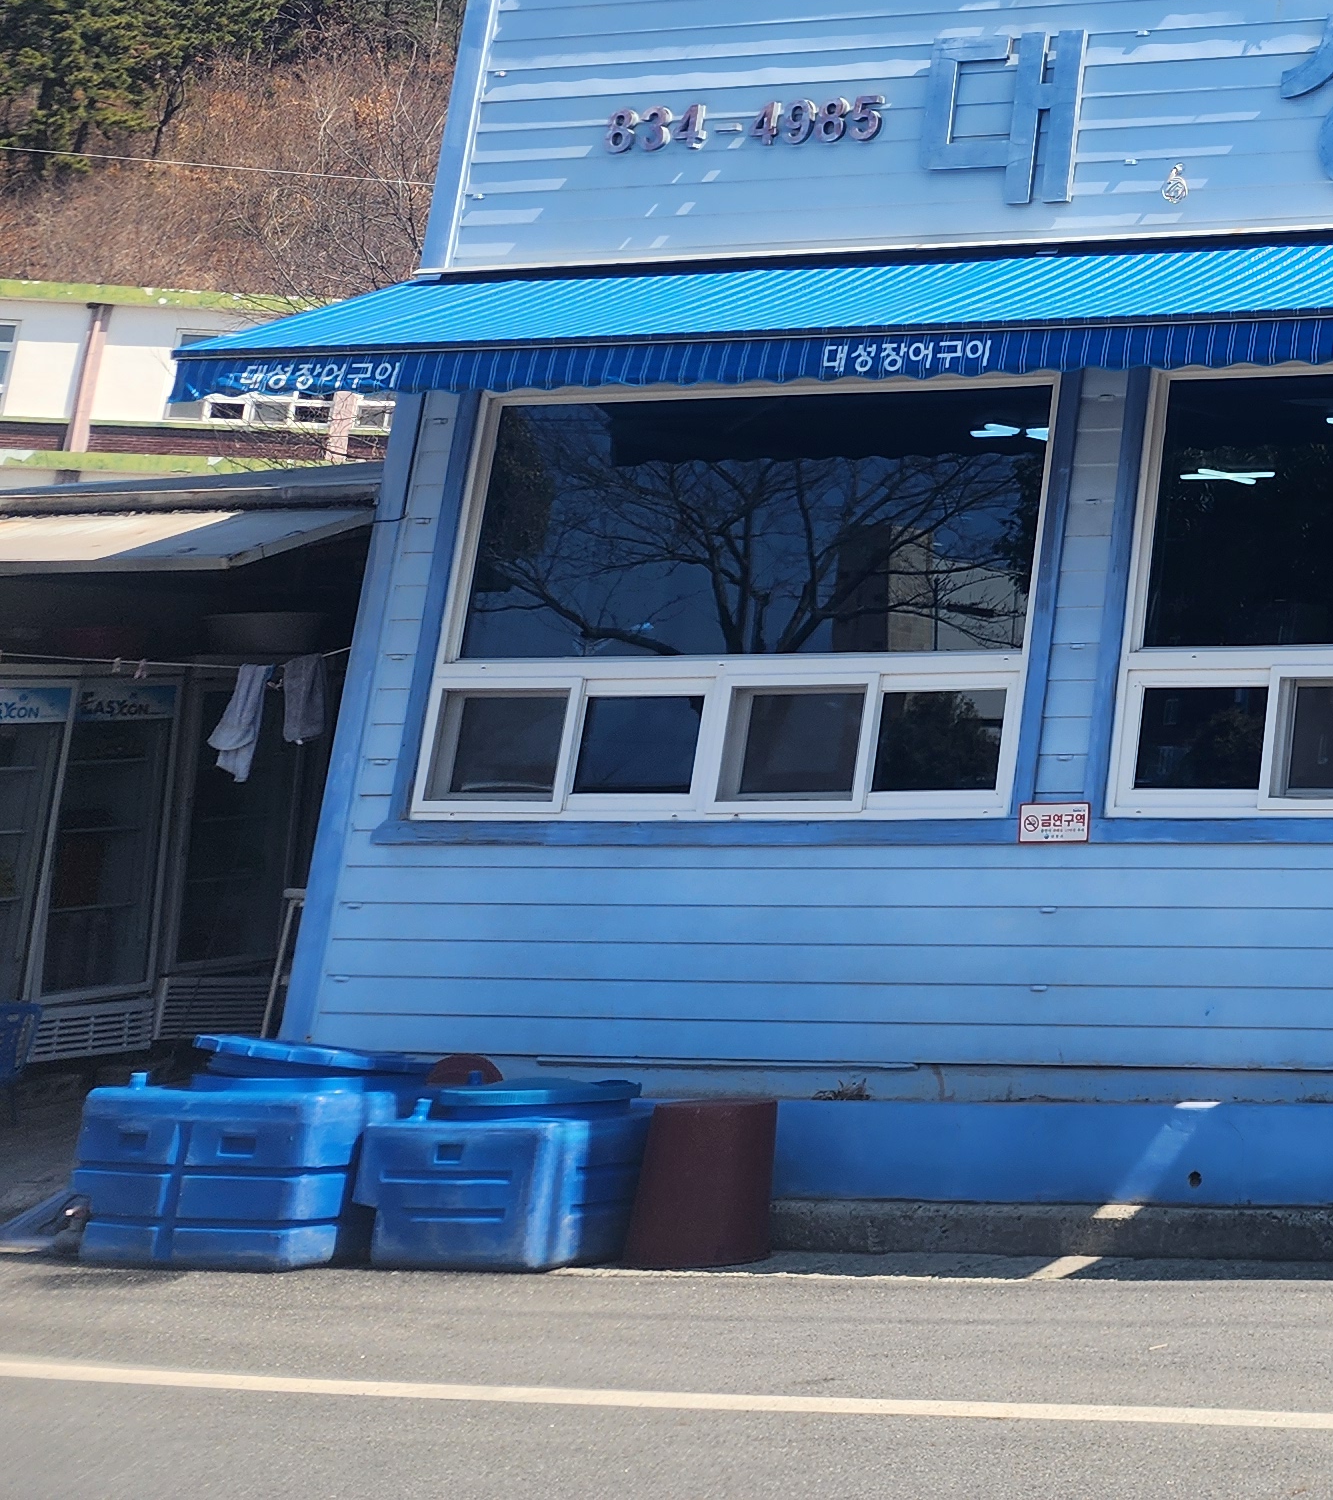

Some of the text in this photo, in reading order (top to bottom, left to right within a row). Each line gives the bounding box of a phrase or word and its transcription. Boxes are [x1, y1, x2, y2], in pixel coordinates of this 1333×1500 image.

[604, 95, 886, 154] 834-4985
[823, 339, 992, 376] 대성장어구이
[239, 362, 401, 390] 대성장어구이
[1041, 813, 1086, 828] 금연구역
